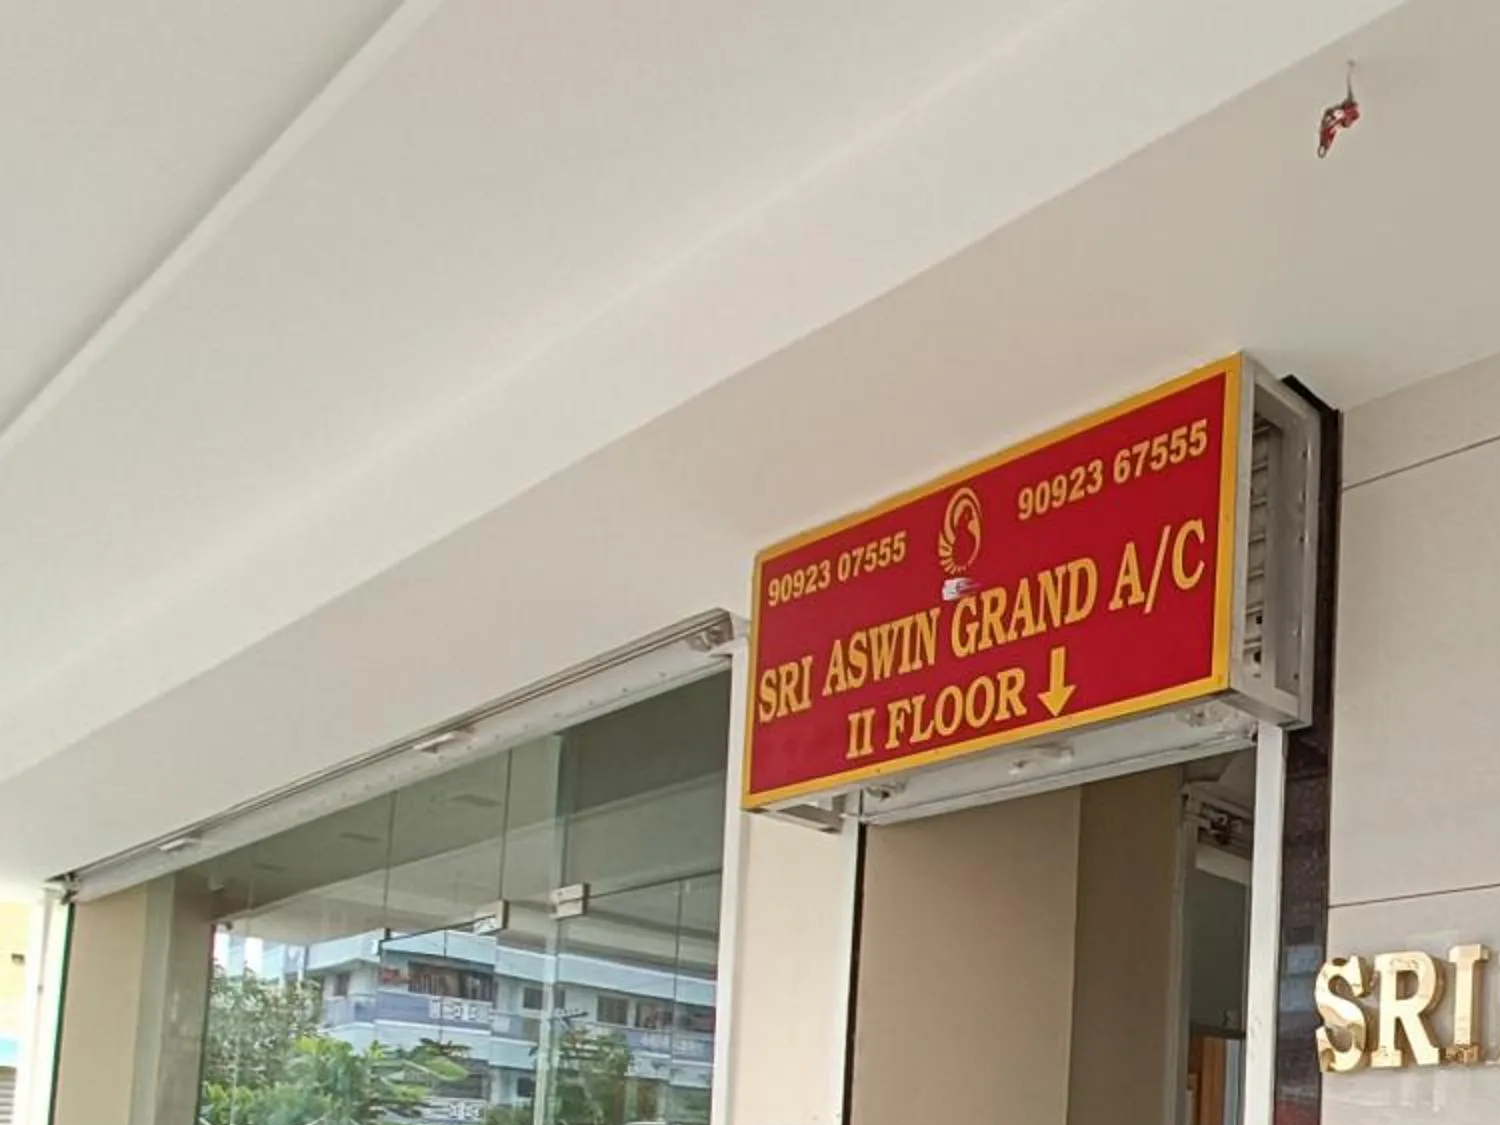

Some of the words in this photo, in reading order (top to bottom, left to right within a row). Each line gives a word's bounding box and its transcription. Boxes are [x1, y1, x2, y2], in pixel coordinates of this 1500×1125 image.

[1017, 460, 1104, 520] 90923
[1113, 419, 1209, 485] 67555
[767, 562, 831, 607] 90923
[837, 531, 907, 581] 07555
[758, 655, 813, 723] SRI
[822, 608, 941, 696] ASWIN
[951, 557, 1098, 659] GRAND
[1108, 519, 1206, 613] A/C
[845, 707, 876, 759] II
[885, 667, 1027, 750] FLOOR
[1314, 943, 1490, 1073] SRI
